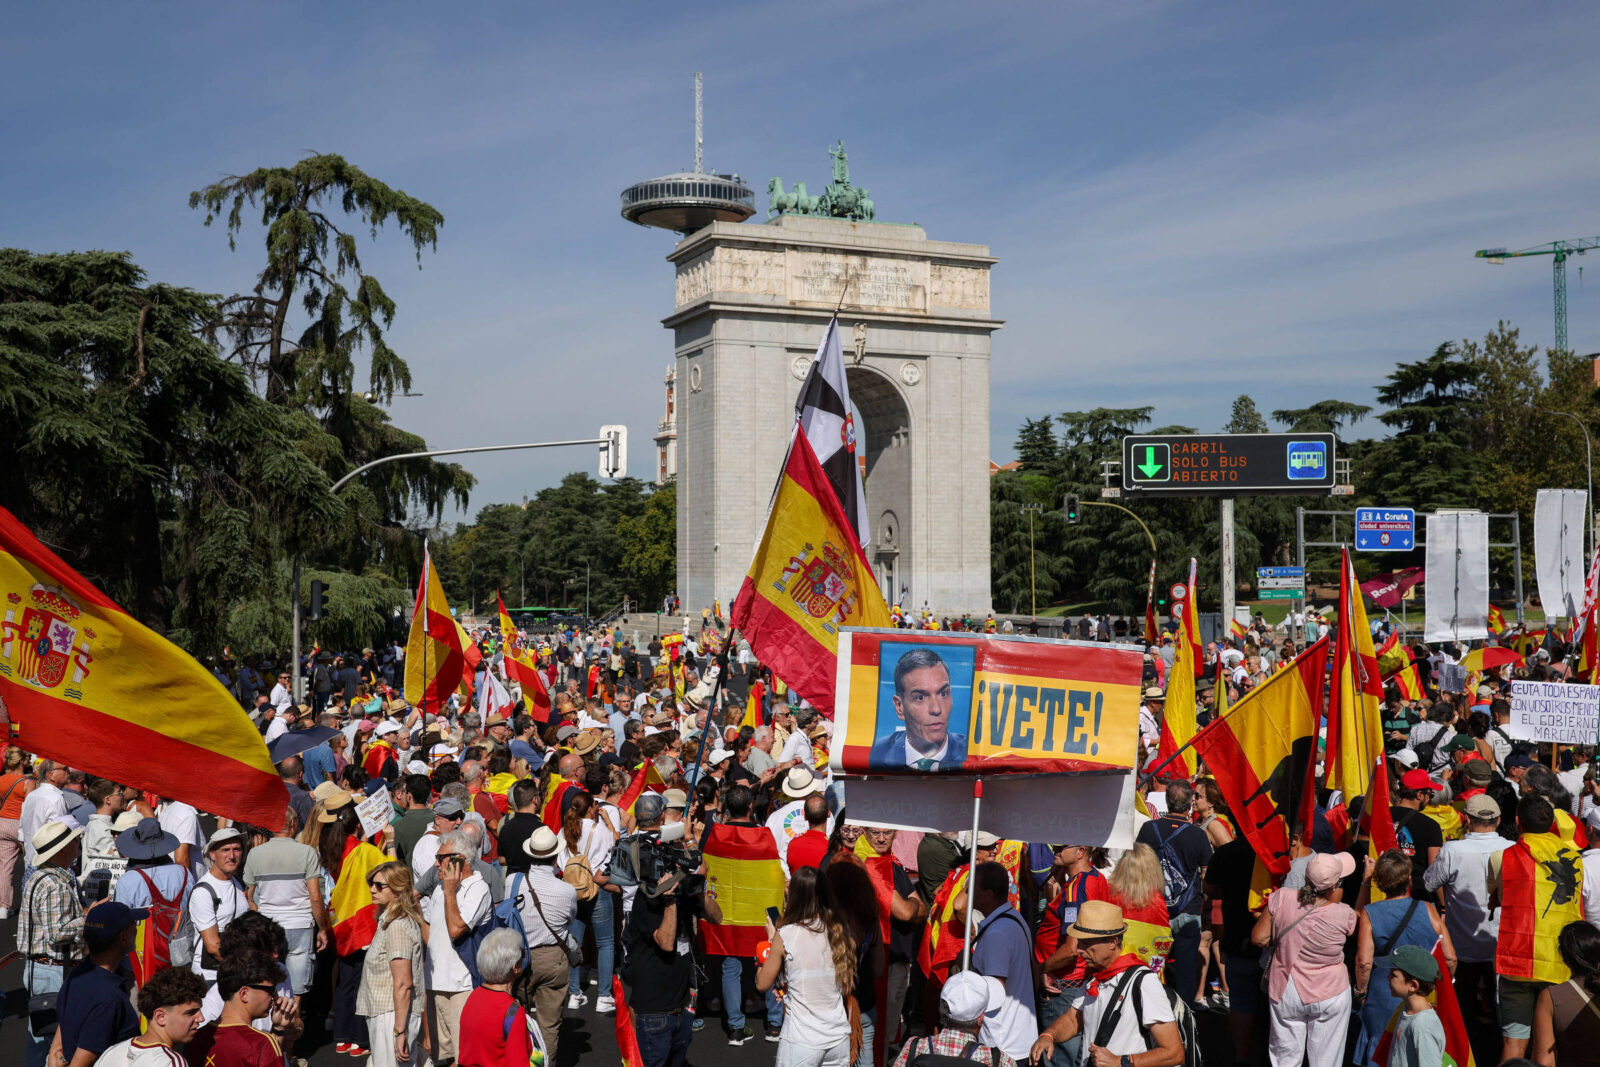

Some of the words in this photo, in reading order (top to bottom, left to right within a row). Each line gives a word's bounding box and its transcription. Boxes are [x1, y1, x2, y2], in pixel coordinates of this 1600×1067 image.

[1172, 442, 1228, 454] CARRIL
[1172, 457, 1209, 468] SOLO
[1219, 456, 1248, 468] BUS
[1172, 470, 1239, 482] ABIERTO
[1375, 513, 1382, 521] A
[1384, 512, 1408, 521] Coruña
[1542, 684, 1566, 698] TODA
[1511, 698, 1527, 711] CON
[1572, 702, 1600, 716] MENOS
[974, 679, 1104, 757] ¡VETE!
[1521, 713, 1536, 726] EL
[1539, 714, 1599, 729] GOBIERNO
[1534, 726, 1598, 745] MARCIANO
